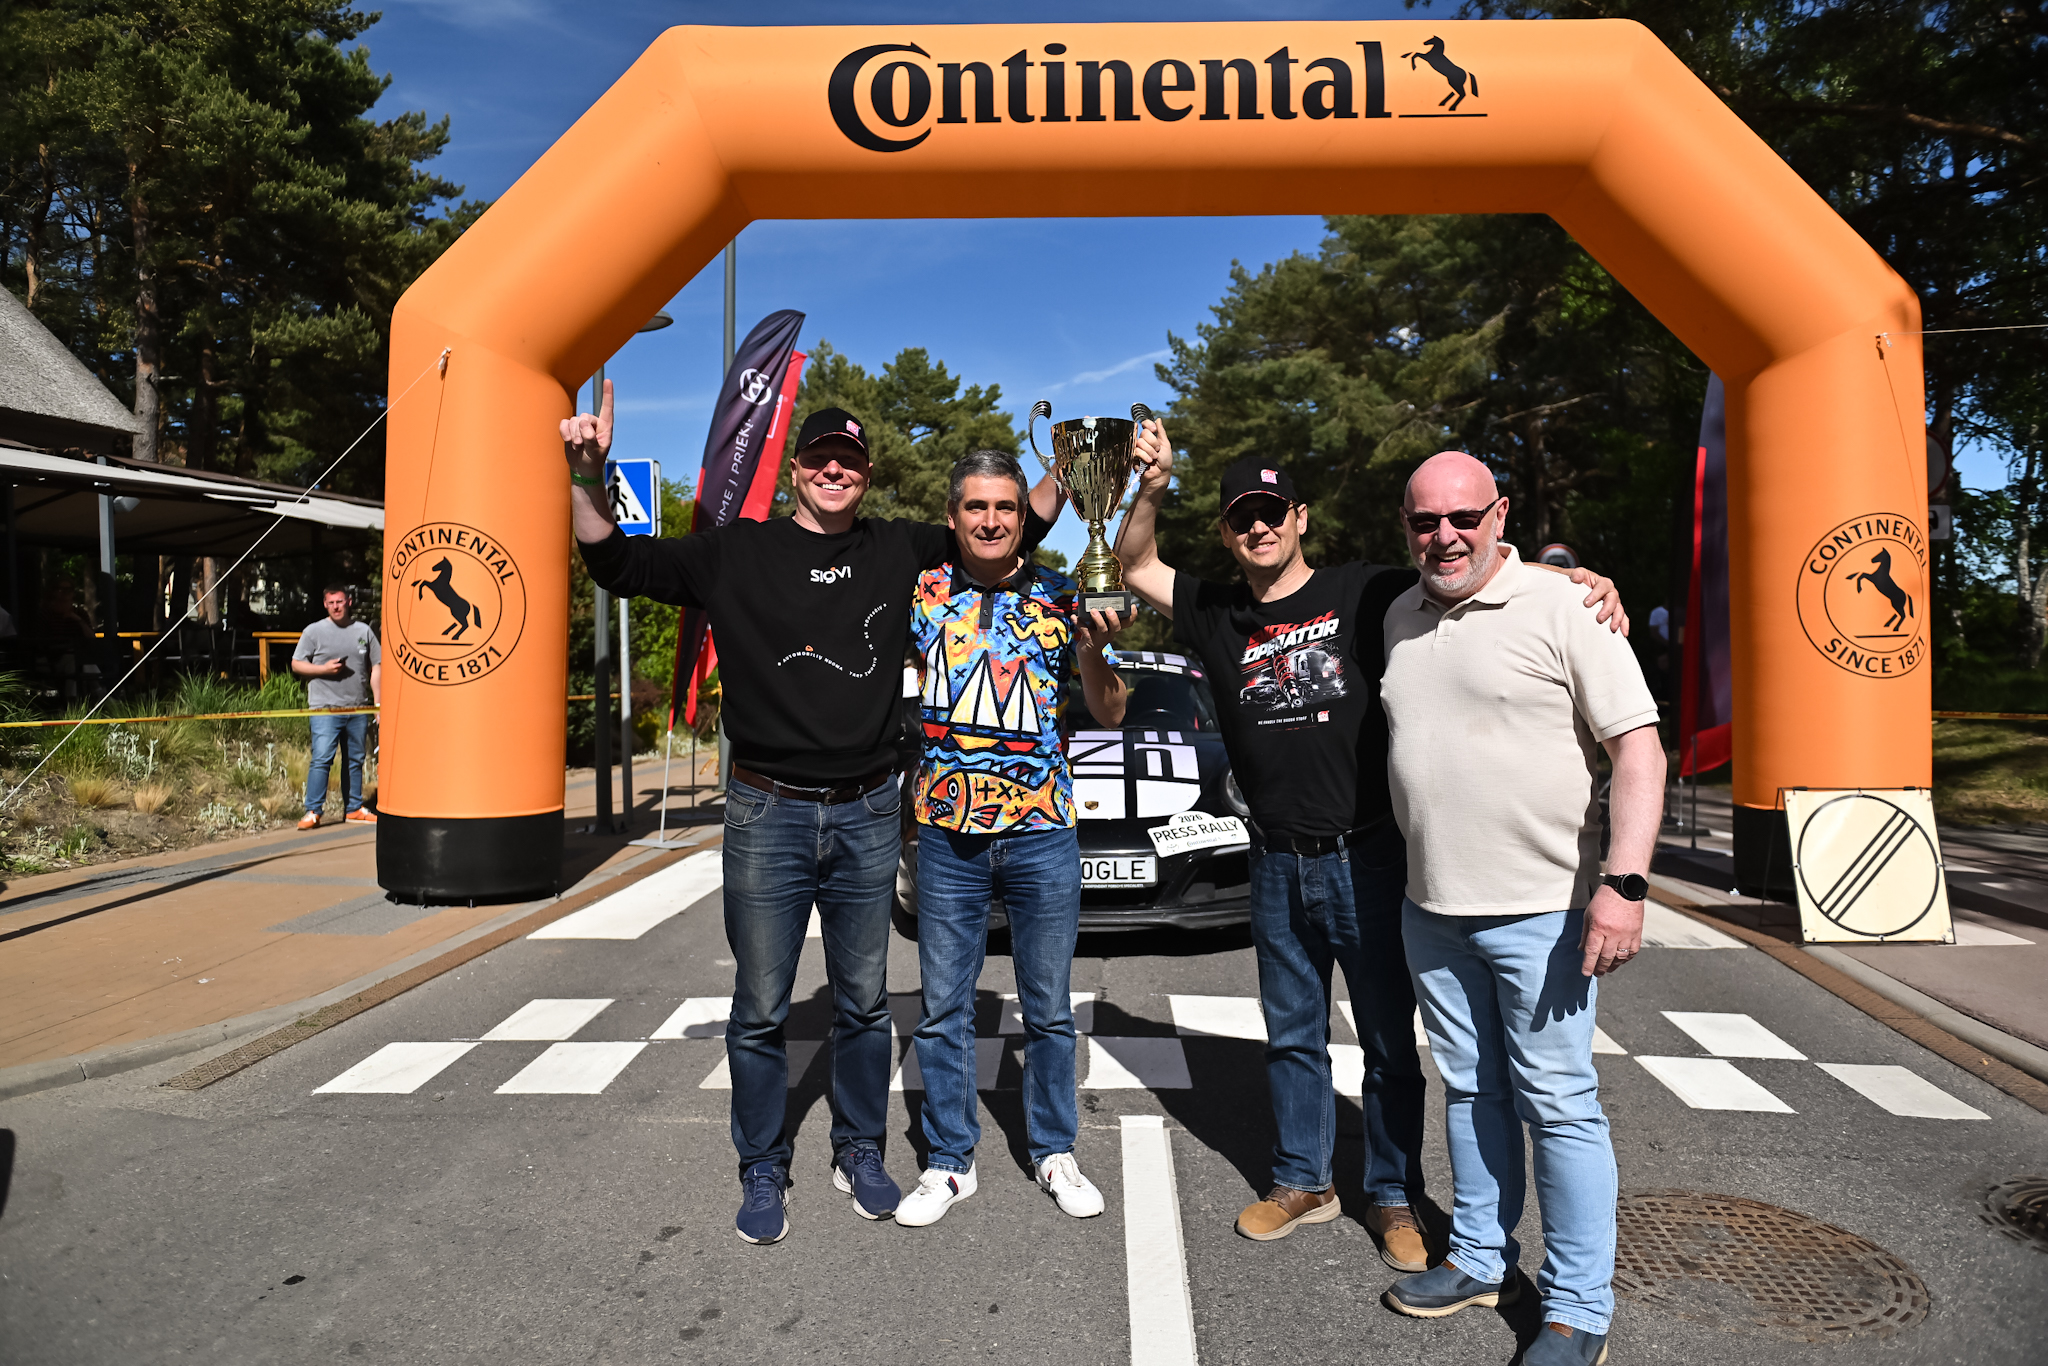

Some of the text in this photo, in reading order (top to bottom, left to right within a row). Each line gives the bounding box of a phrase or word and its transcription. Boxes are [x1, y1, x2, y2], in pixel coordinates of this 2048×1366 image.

[828, 41, 1392, 152] Continental
[391, 528, 515, 586] CONTINENTAL
[1809, 519, 1927, 575] CONTINENTAL
[396, 643, 503, 681] SINCE 1871
[1824, 635, 1925, 674] SINCE 1871
[1153, 820, 1238, 843] PRESS RALLY
[1178, 814, 1203, 823] 2026
